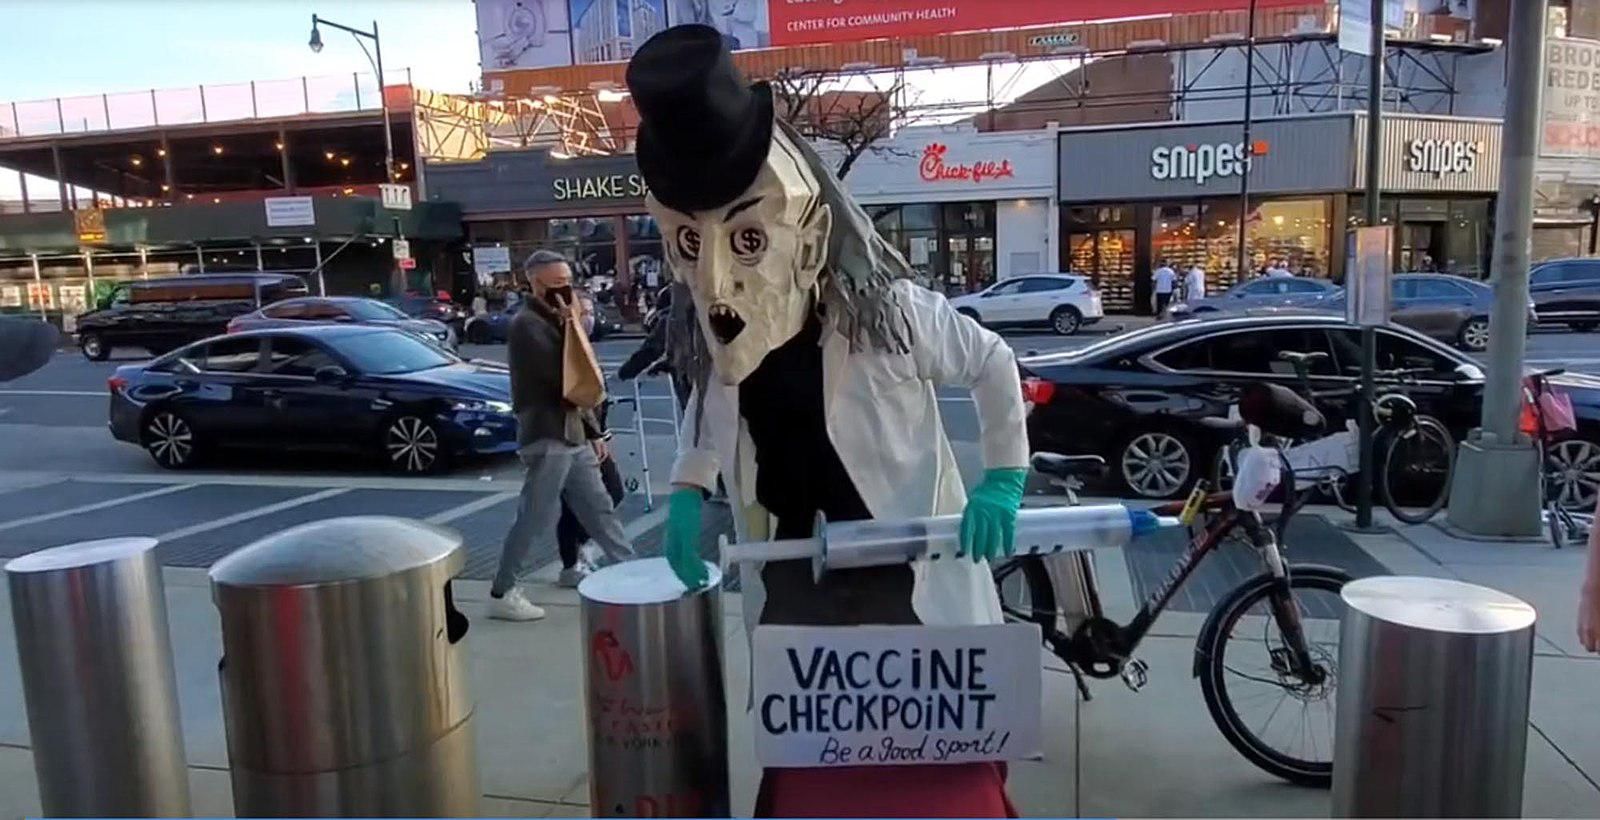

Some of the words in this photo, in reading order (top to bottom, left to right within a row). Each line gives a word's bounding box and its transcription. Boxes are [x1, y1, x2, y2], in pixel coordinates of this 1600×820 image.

[787, 18, 825, 32] CENTER
[826, 17, 846, 29] FOR
[847, 11, 913, 27] COMMUNITY
[916, 7, 956, 20] HEALTH
[920, 145, 1013, 183] Chick-fil-A
[1152, 143, 1252, 184] snipes
[1410, 139, 1477, 180] snipes
[553, 176, 624, 200] SHAKE
[819, 736, 851, 763] Be
[858, 745, 874, 761] a
[878, 734, 928, 763] good
[933, 731, 1011, 761] sport!
